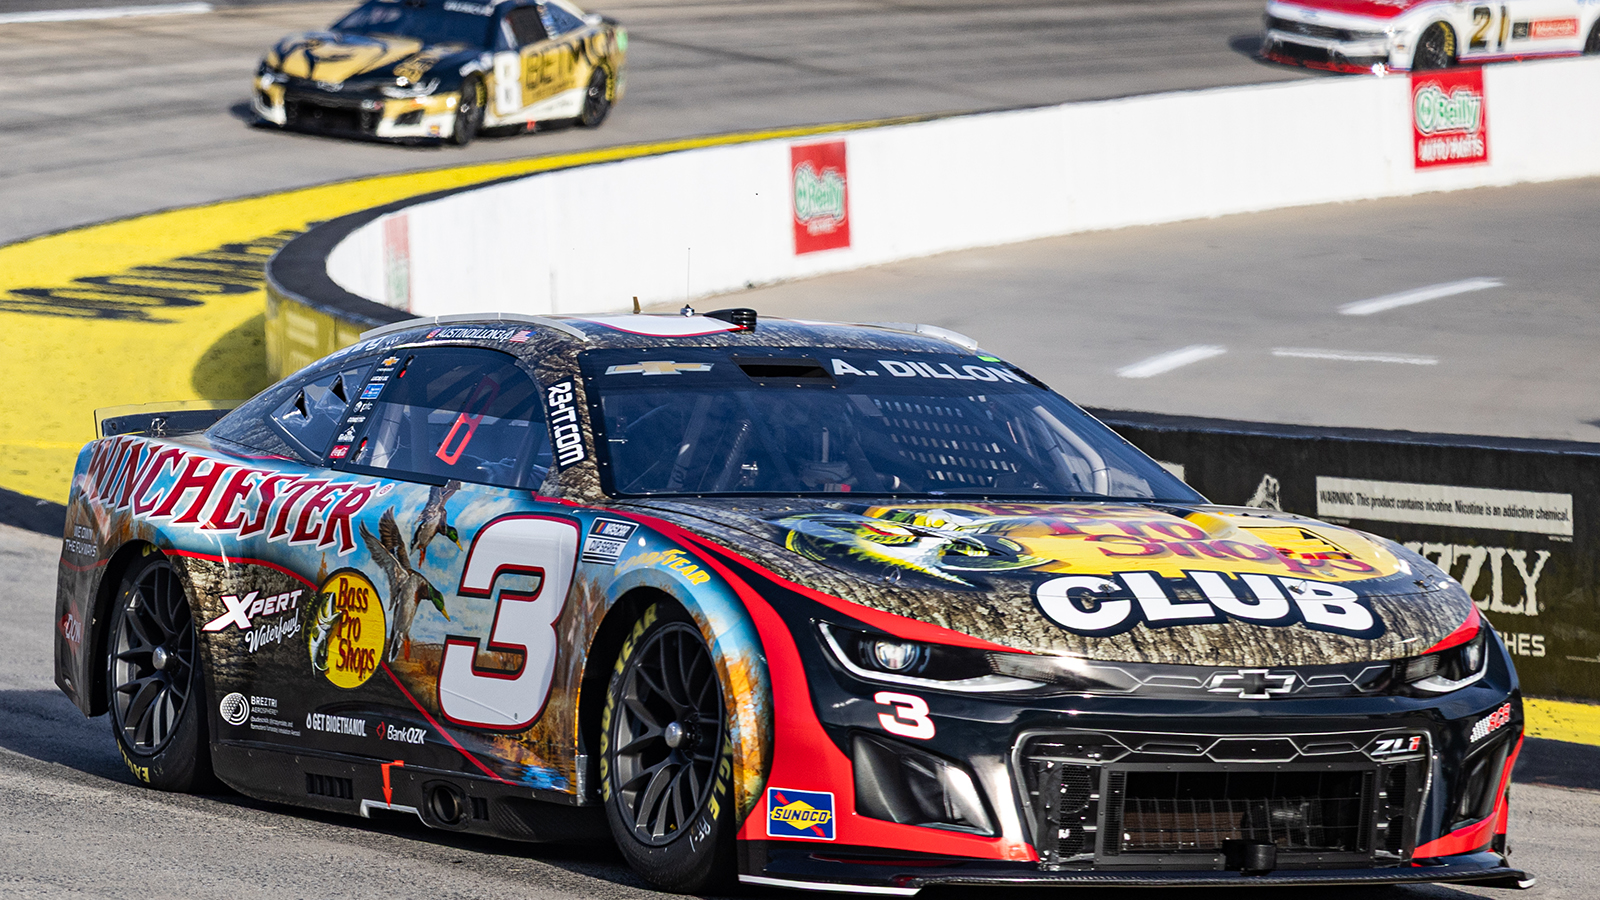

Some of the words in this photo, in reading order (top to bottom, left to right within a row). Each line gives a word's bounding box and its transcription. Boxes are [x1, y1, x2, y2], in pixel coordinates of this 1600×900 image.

[1469, 6, 1509, 49] 21
[494, 51, 523, 114] 8
[831, 358, 879, 377] A.
[879, 359, 1027, 384] DILLON
[79, 434, 381, 556] WINCHESTER
[1356, 492, 1370, 507] This
[1371, 494, 1396, 511] product
[1396, 496, 1425, 511] contains
[1455, 500, 1484, 516] Nicotine
[1503, 503, 1534, 520] addictive
[588, 540, 601, 551] CUP
[600, 541, 621, 554] SERIES
[1082, 534, 1377, 575] Shops
[613, 549, 711, 585] GOODYEAR
[201, 589, 303, 632] XPERT
[336, 577, 370, 612] Bass
[1036, 571, 1375, 632] CLUB
[245, 608, 301, 654] Waterfowl
[336, 608, 362, 641] Pro
[438, 513, 581, 733] 3
[335, 637, 377, 680] Shops
[250, 695, 278, 708] BREZTRI
[873, 691, 936, 740] 3
[312, 712, 326, 732] GET
[326, 714, 368, 738] BIOETHANOL
[1370, 735, 1422, 757] ZL1
[773, 807, 829, 823] SUNOCO
